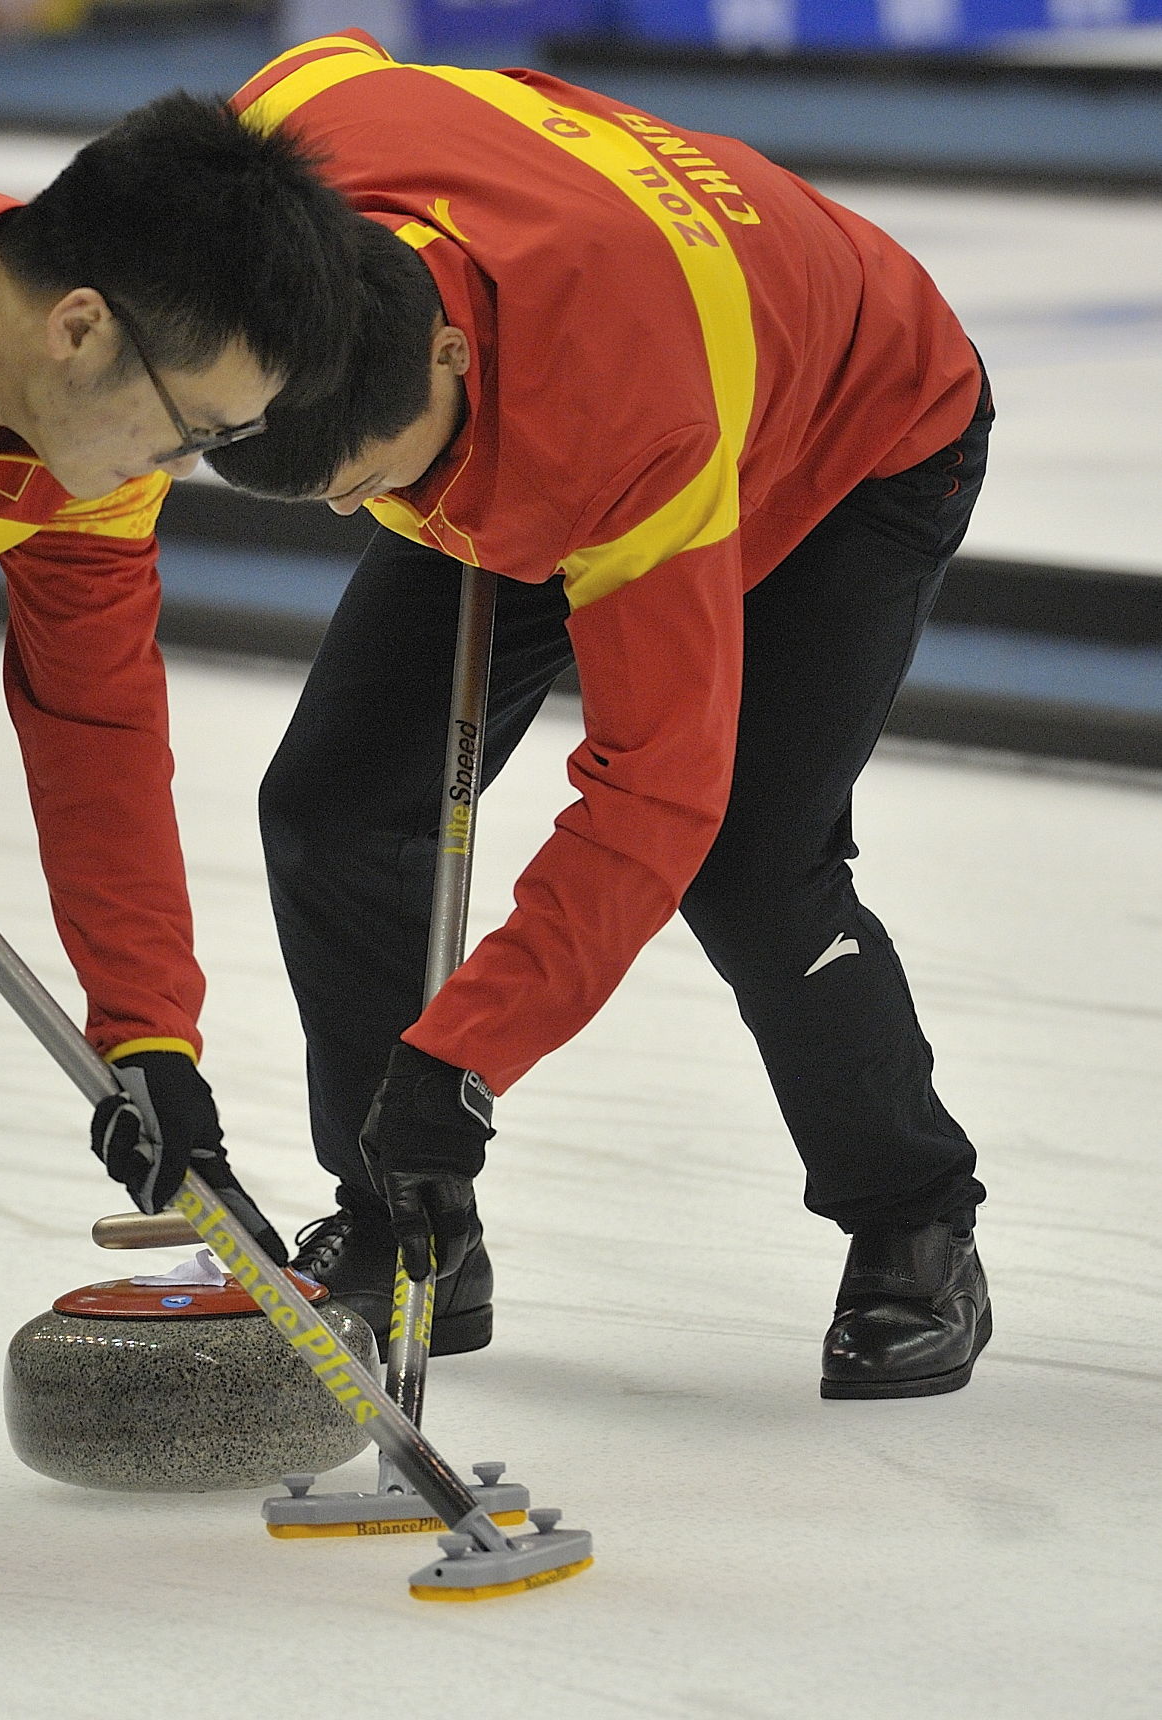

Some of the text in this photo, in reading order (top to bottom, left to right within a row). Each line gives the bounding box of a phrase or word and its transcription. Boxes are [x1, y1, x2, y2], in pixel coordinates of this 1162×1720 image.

[612, 111, 761, 225] CHINA
[628, 166, 720, 248] Zou
[175, 1172, 381, 1425] alancePlus
